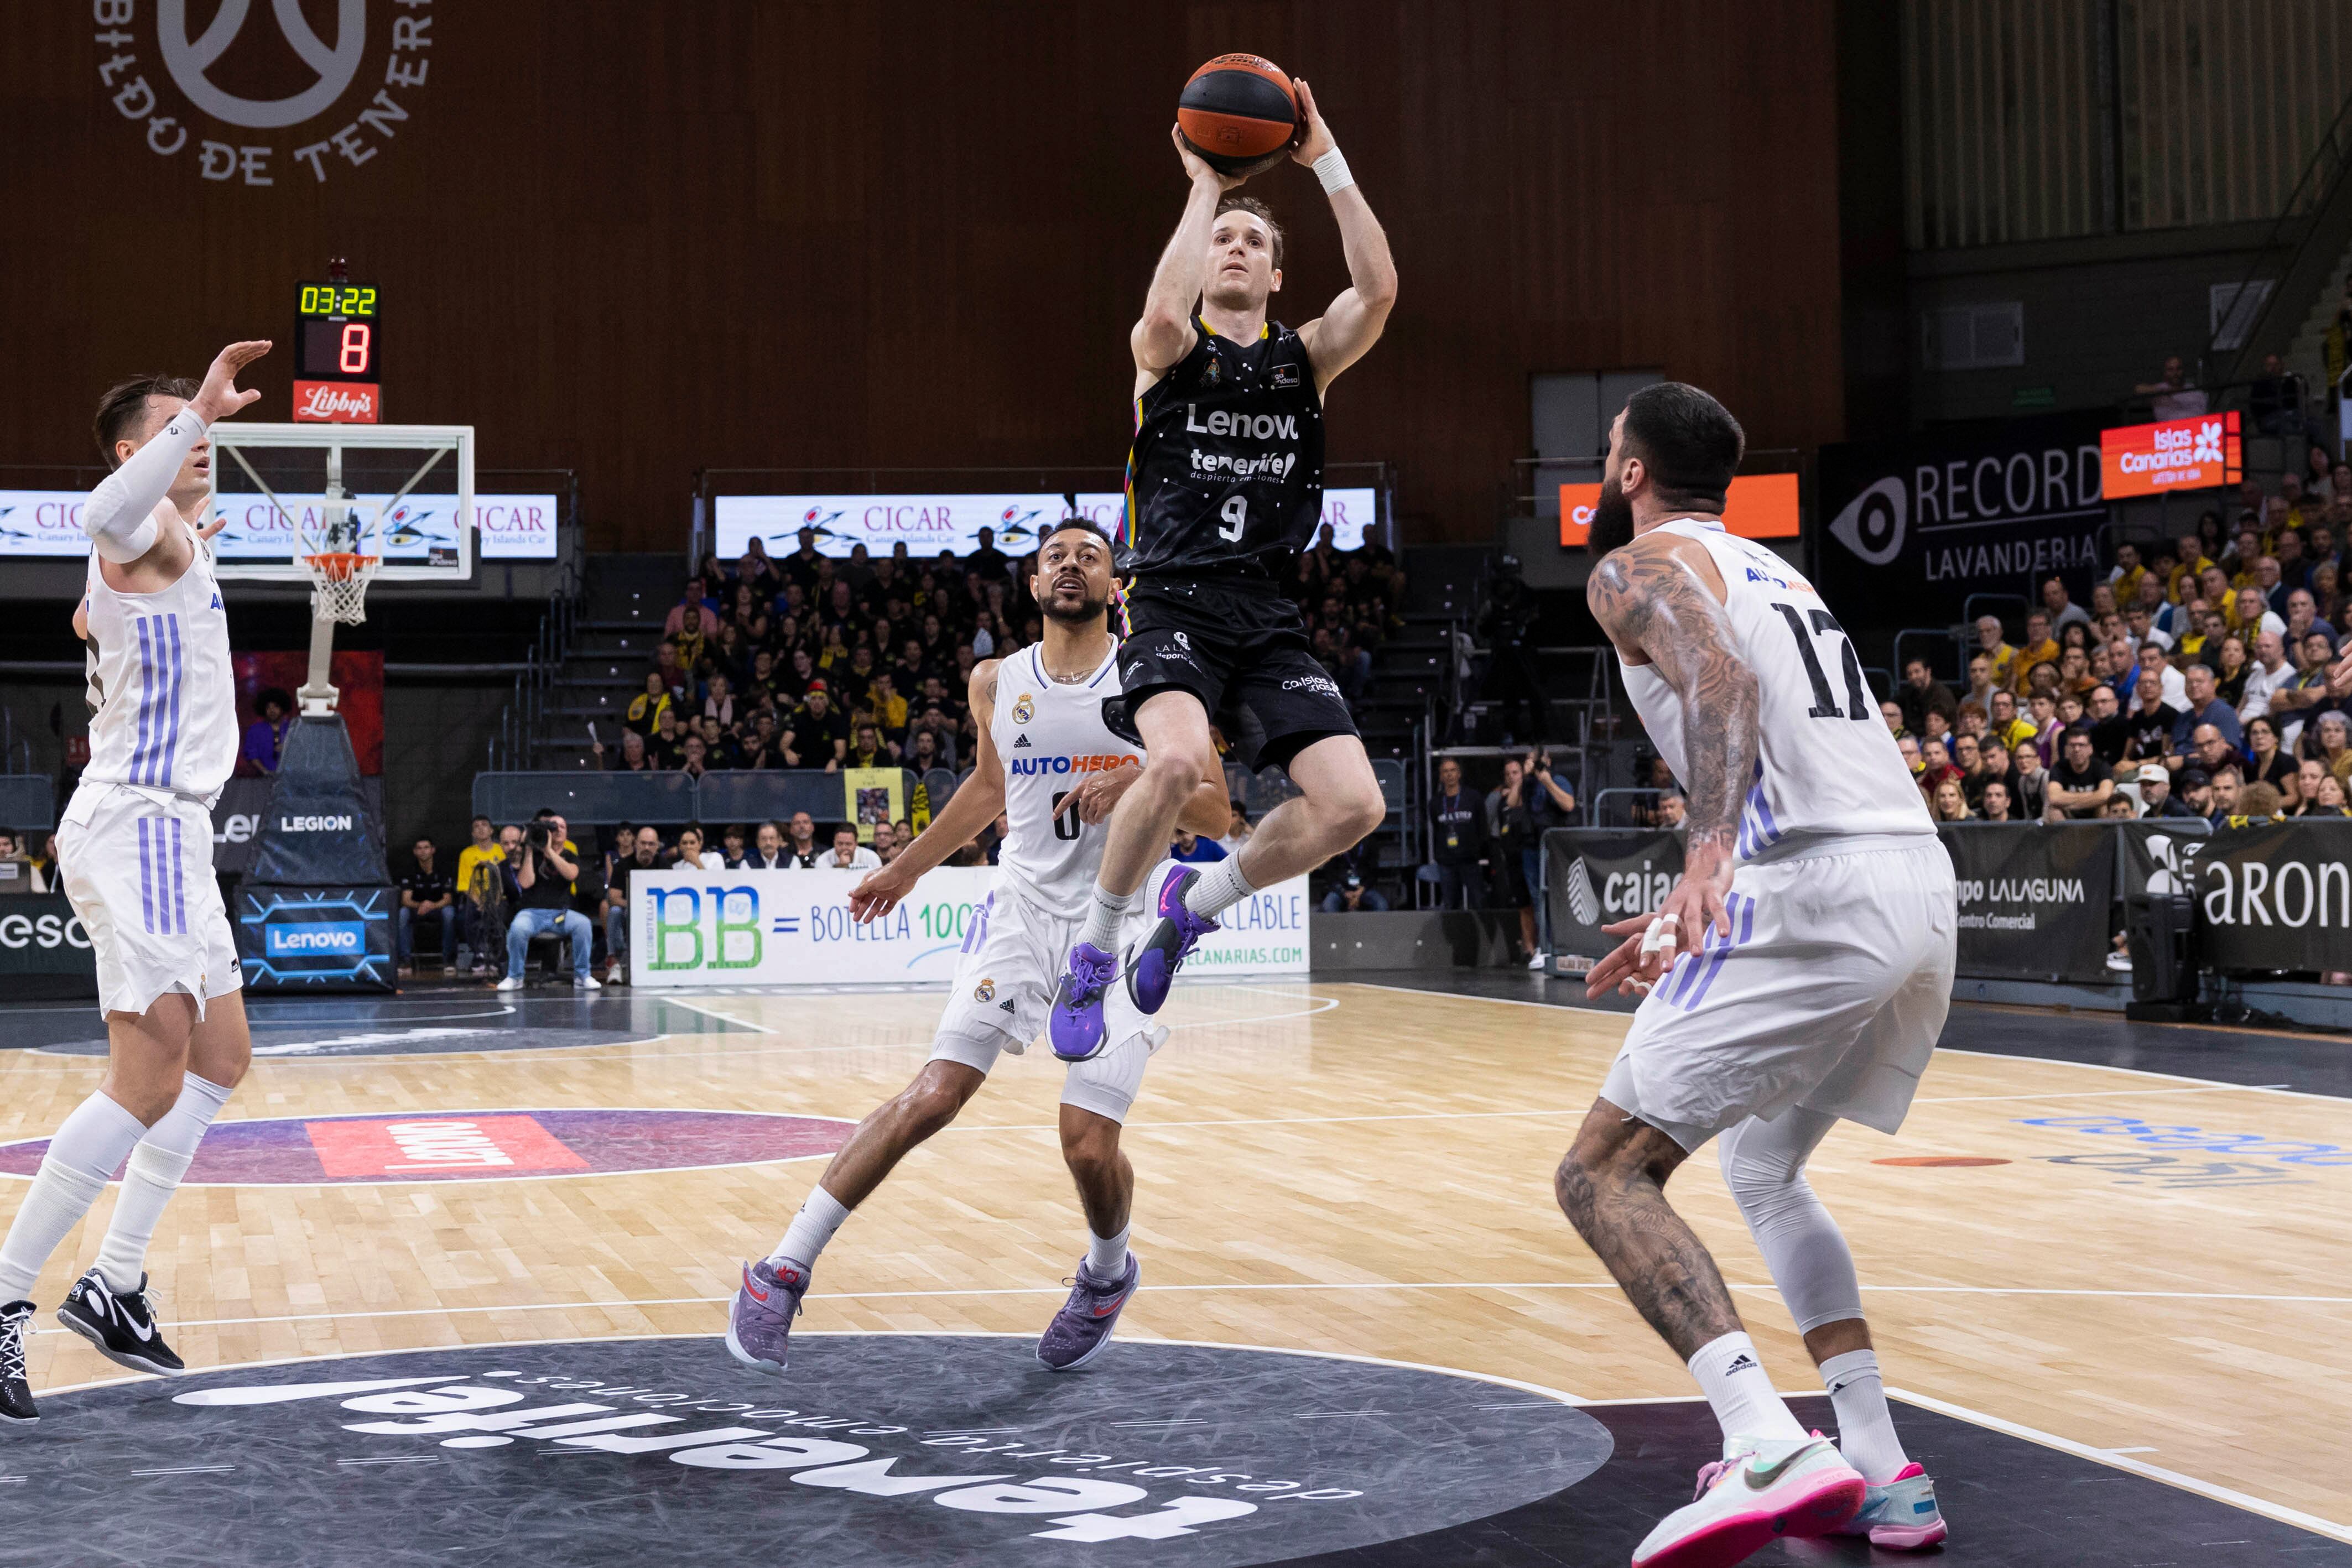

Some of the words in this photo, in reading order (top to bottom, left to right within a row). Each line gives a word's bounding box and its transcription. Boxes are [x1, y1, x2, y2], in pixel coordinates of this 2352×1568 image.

[199, 139, 274, 185] DE
[301, 287, 376, 315] 03:22
[340, 324, 370, 373] 8
[298, 385, 372, 418] Libby's
[2154, 428, 2193, 450] Islas
[2120, 449, 2193, 474] Canarias
[1190, 471, 1236, 483] despierta
[1916, 445, 2101, 524] RECORD
[246, 504, 329, 531] CICA
[864, 506, 955, 532] CICAR
[1219, 495, 1248, 543] 9
[939, 533, 955, 543] Car
[1770, 602, 1870, 721] 17
[1012, 754, 1139, 775] AUTOHERO
[281, 815, 352, 832] LEGION
[1052, 791, 1081, 841] 0
[647, 885, 763, 971] BB
[811, 903, 910, 942] BOTELLA
[1956, 912, 1985, 929] entro
[1986, 911, 2036, 930] Comercial
[274, 930, 357, 949] Lenovo
[999, 1004, 1015, 1015] adidas
[1725, 1362, 1758, 1377] adidas
[514, 1374, 908, 1436] emociones
[171, 1371, 1259, 1543] tenerife!
[920, 1433, 1364, 1500] despierta
